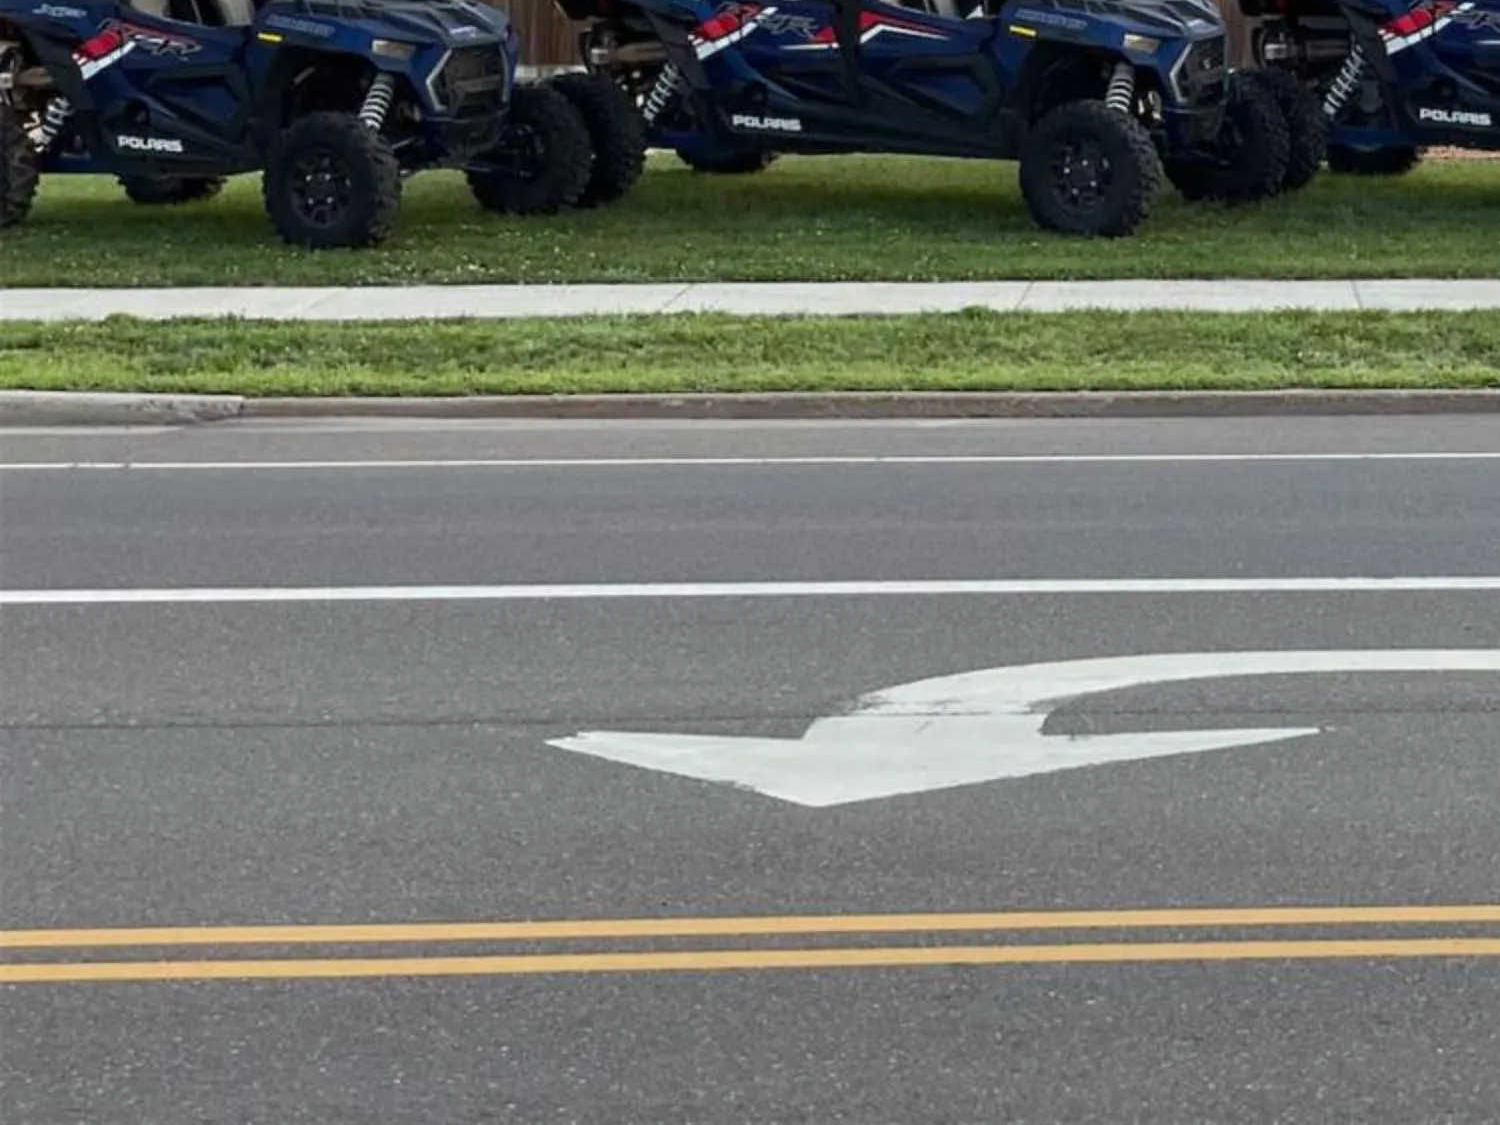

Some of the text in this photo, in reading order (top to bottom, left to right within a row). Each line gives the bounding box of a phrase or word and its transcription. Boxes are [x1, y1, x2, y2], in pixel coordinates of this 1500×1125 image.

[733, 114, 802, 132] POLARIS
[1419, 107, 1492, 126] POLARIS
[117, 135, 183, 153] POLARIS
